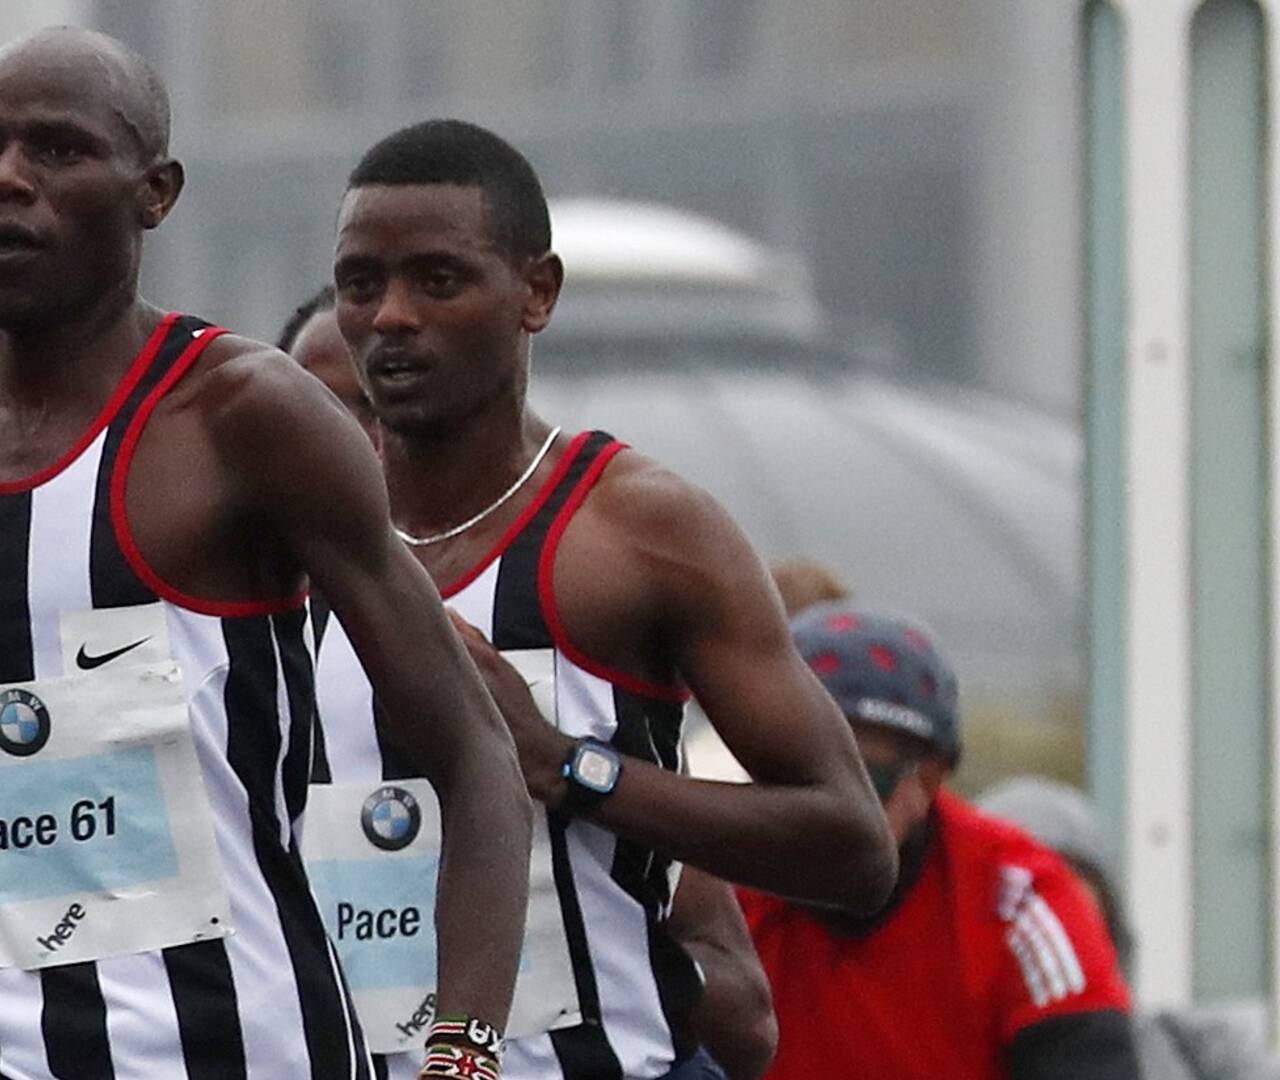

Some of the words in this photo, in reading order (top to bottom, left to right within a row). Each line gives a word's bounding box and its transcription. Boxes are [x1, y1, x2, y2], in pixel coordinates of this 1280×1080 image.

[70, 797, 116, 841] 61
[37, 902, 87, 951] here
[337, 903, 421, 941] Pace
